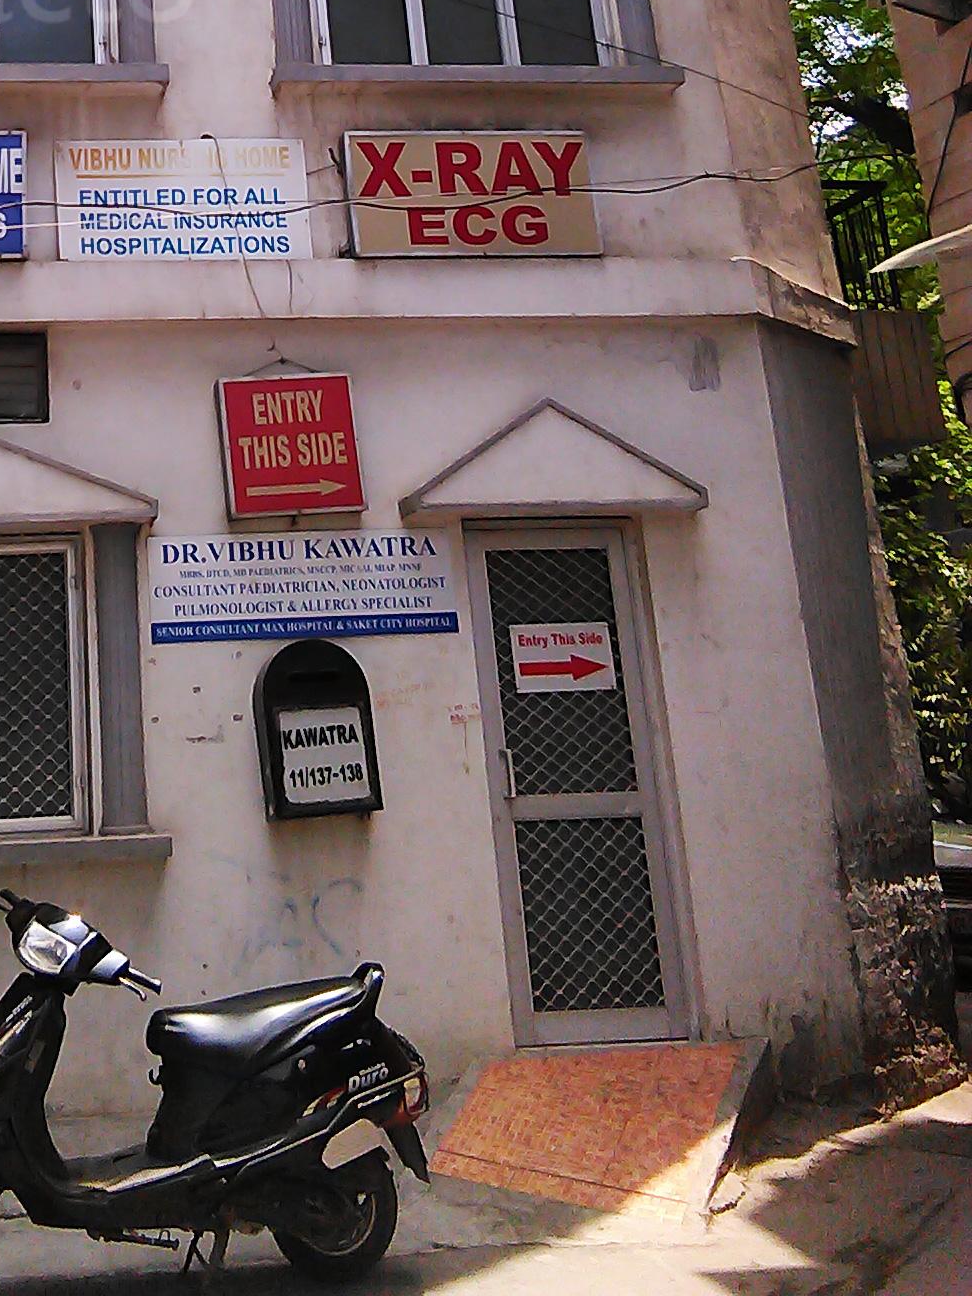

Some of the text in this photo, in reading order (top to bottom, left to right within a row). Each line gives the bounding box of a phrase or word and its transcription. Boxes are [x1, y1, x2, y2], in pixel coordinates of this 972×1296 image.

[69, 147, 132, 171] VIBHU
[355, 140, 584, 198] X-RAY
[79, 188, 286, 207] ENTITLED FOR ALL
[80, 211, 288, 230] MEDICAL INSURANCE
[406, 204, 550, 246] ECG
[81, 236, 290, 255] HOSPITALIZATIONS
[252, 389, 323, 426] ENTRY
[238, 432, 349, 470] THIS SIDE
[303, 535, 438, 559] KAWATRA
[153, 576, 447, 599] CONSULTANT PAEDIATRICIAN, NEONATOLOGIST
[174, 596, 433, 618] PULMONOLOGIST & ALLERGY SPECIALIST
[156, 617, 451, 637] SENIOR CONSULTANT MAX HOSPITAL & SAKET CITY HOSPITAL
[517, 631, 603, 649] Entry This Side
[282, 723, 359, 750] KAWATRA
[289, 763, 364, 789] 11/137-138
[348, 1067, 389, 1094] Duro
